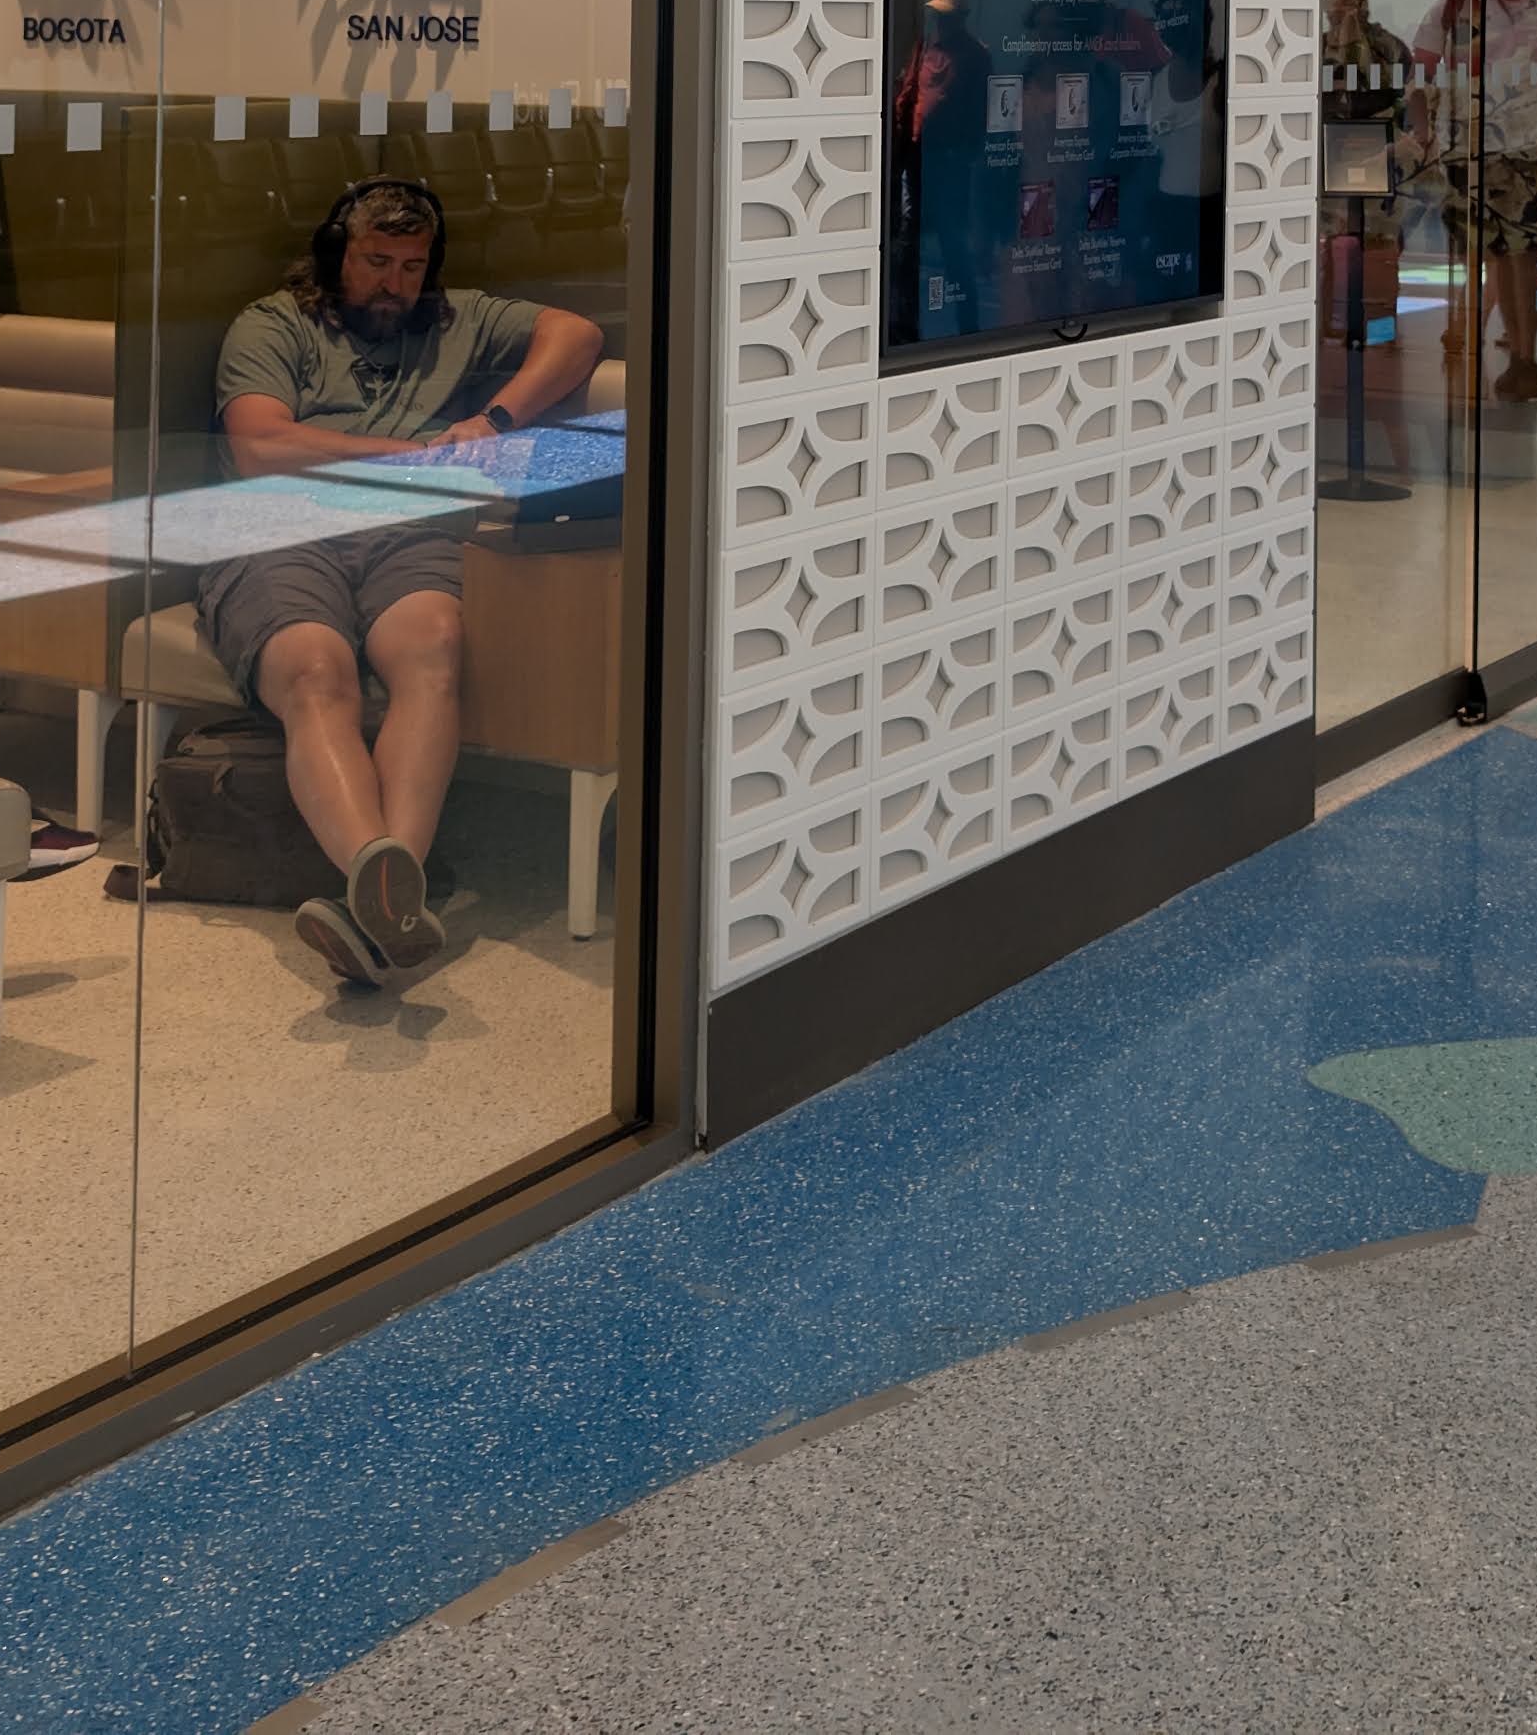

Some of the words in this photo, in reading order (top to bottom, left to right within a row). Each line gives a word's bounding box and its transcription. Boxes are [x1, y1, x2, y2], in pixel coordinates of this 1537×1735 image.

[22, 16, 126, 44] BOGOTA
[347, 14, 405, 43] SAN
[410, 16, 480, 44] JOSE
